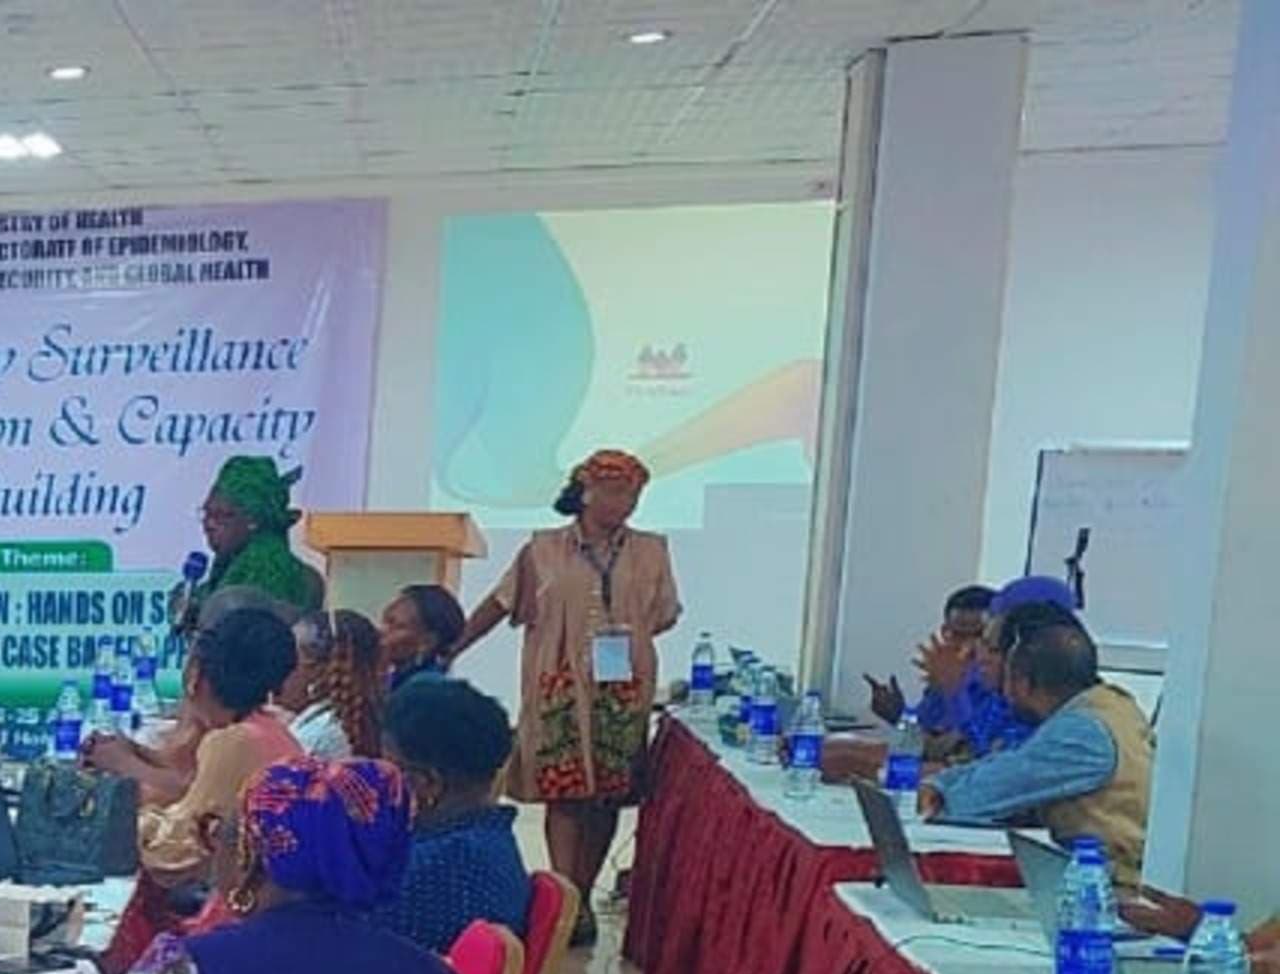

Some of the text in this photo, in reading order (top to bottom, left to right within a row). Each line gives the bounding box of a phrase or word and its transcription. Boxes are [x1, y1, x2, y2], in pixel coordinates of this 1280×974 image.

[49, 213, 71, 231] OF
[76, 207, 144, 229] HEALTH
[81, 237, 104, 257] OF
[123, 261, 195, 285] GLOBAL
[199, 258, 270, 283] HEALTH
[27, 323, 309, 382] Surveillance
[48, 394, 100, 447] &
[117, 394, 316, 459] Capacity
[1, 548, 87, 568] Theme:
[27, 590, 106, 625] HANDS
[111, 590, 145, 625] ON
[2, 634, 60, 668] CASE
